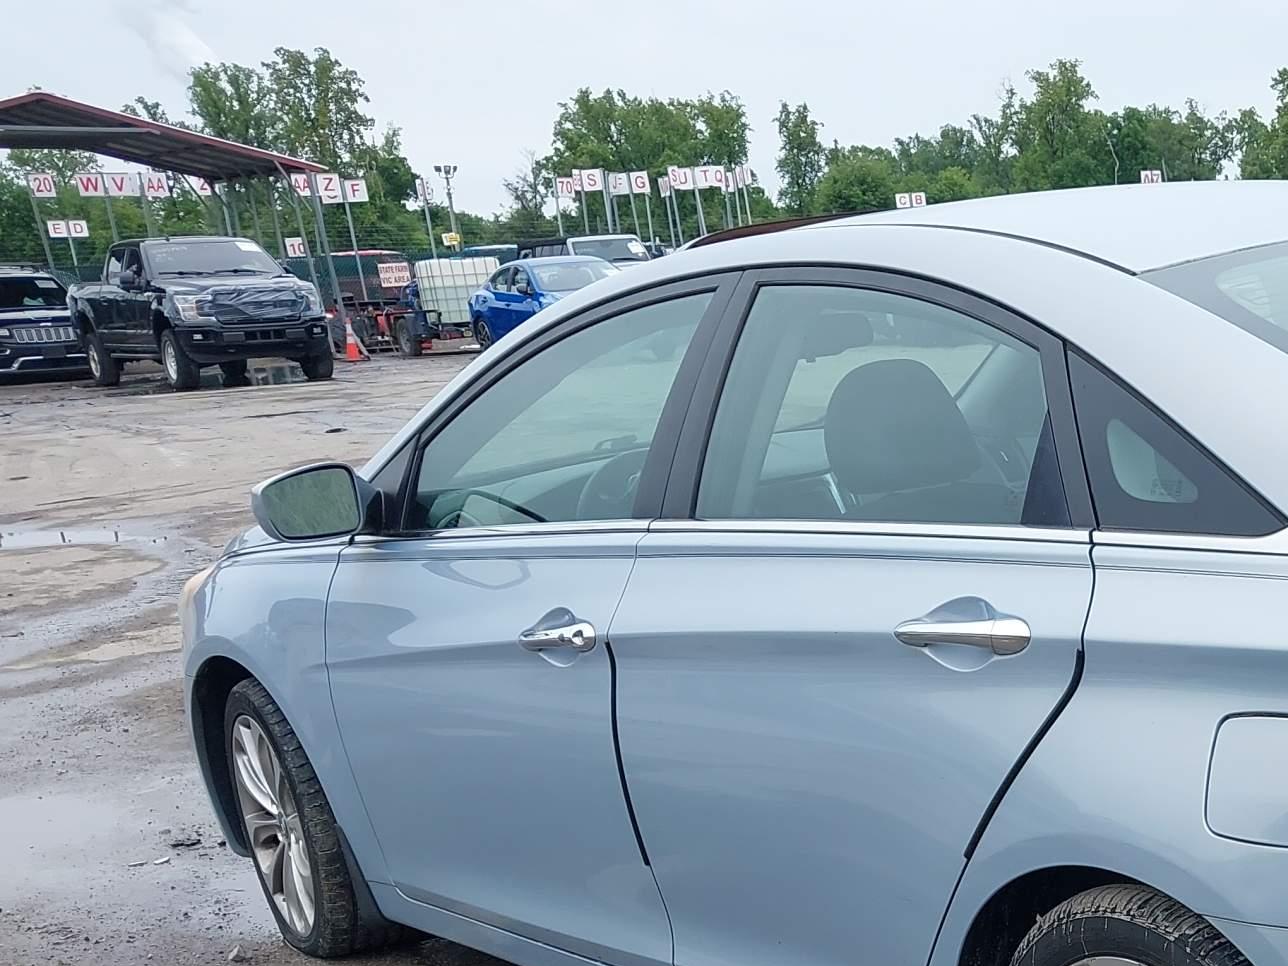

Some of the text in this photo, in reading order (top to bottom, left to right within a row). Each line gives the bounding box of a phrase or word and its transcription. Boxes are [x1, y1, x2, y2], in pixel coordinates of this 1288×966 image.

[587, 173, 597, 187] S
[700, 169, 709, 182] T
[715, 169, 723, 183] Q
[33, 177, 52, 193] 20
[80, 177, 98, 192] W
[112, 177, 124, 192] V
[147, 177, 166, 192] AA
[323, 178, 335, 191] Z
[558, 181, 573, 194] 70
[634, 176, 646, 189] G
[350, 183, 359, 197] F
[899, 196, 907, 205] C
[915, 195, 923, 204] B
[53, 223, 62, 234] E
[74, 223, 83, 234] D
[290, 243, 304, 255] 10
